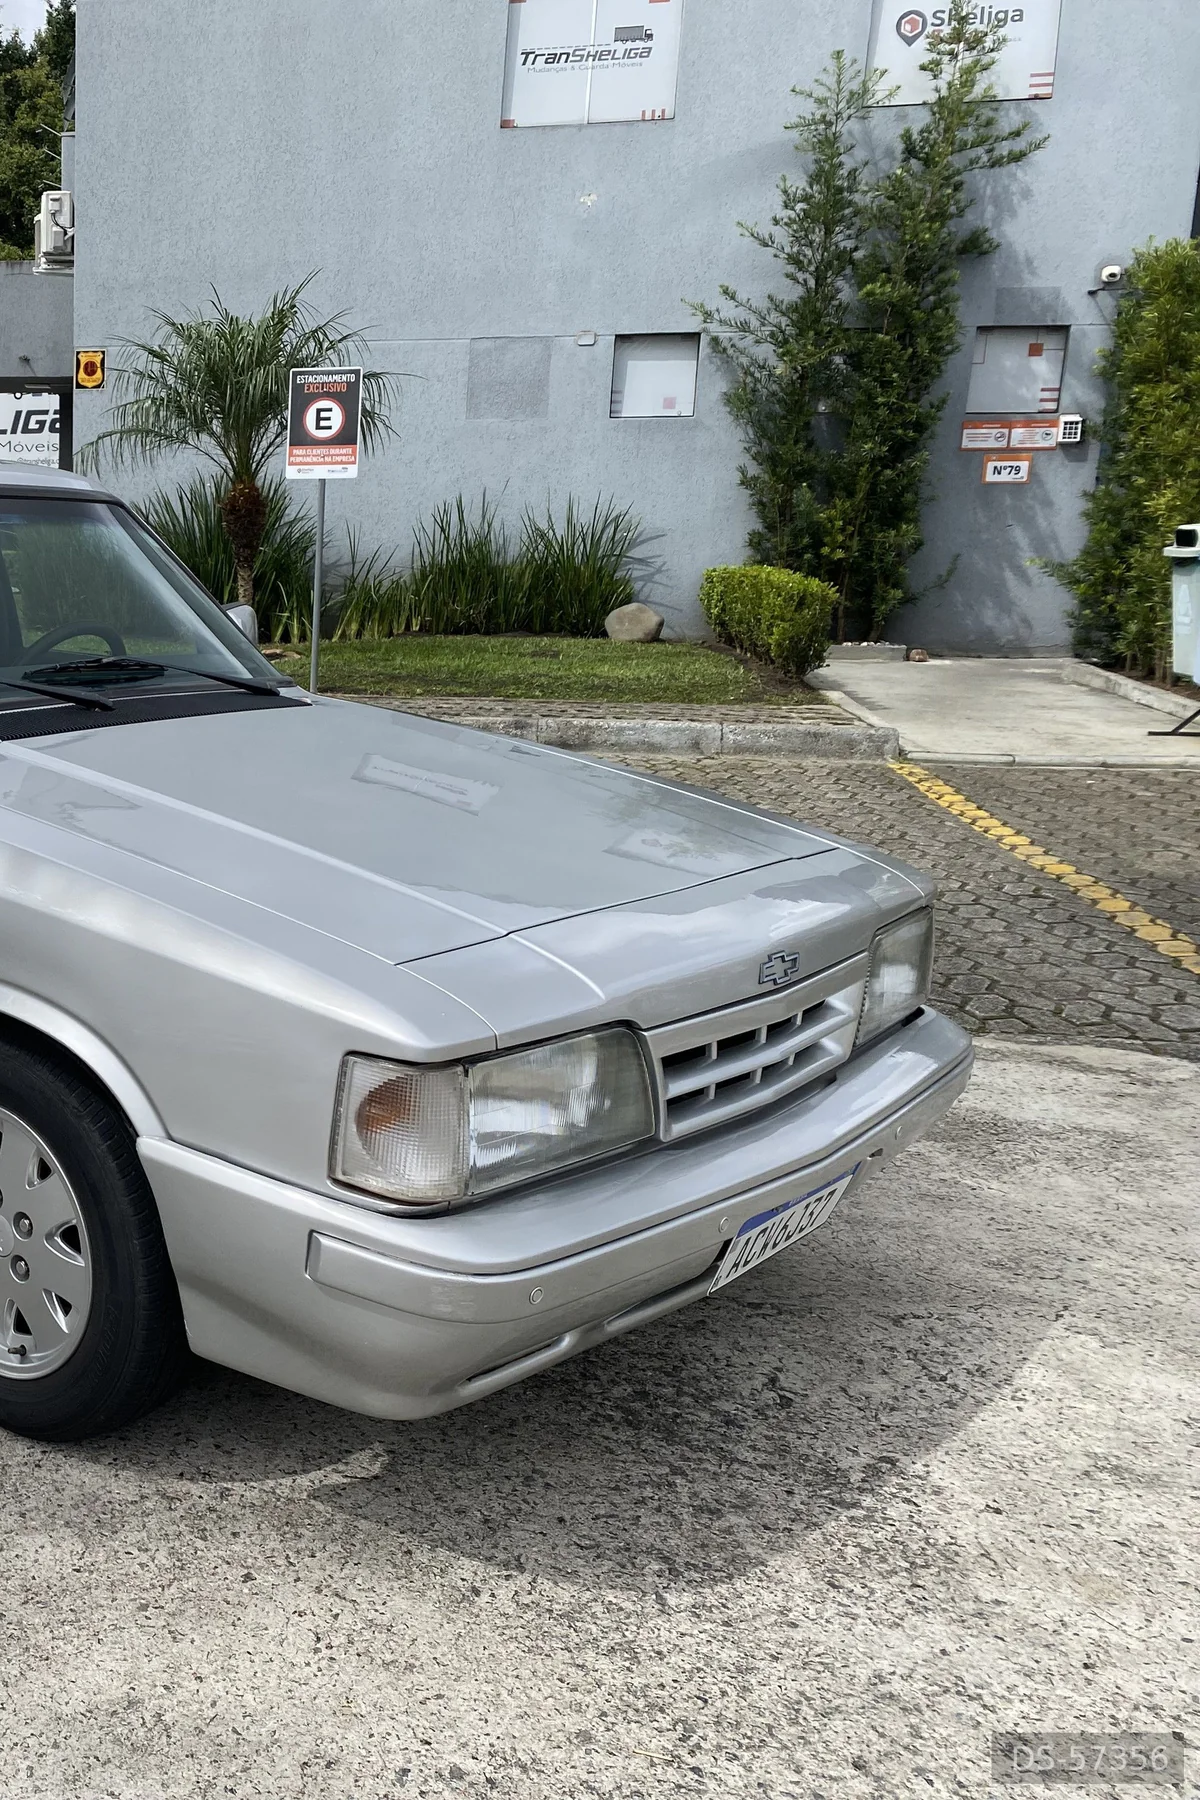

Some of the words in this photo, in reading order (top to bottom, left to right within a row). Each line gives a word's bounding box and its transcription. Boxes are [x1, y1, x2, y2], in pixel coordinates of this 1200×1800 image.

[296, 373, 356, 384] ESTACIONAMENTO
[304, 383, 347, 393] EXCLUSIVO
[315, 407, 333, 430] E
[292, 448, 306, 456] PARA
[330, 447, 353, 455] DURANTE
[726, 1188, 838, 1279] ACW6J37
